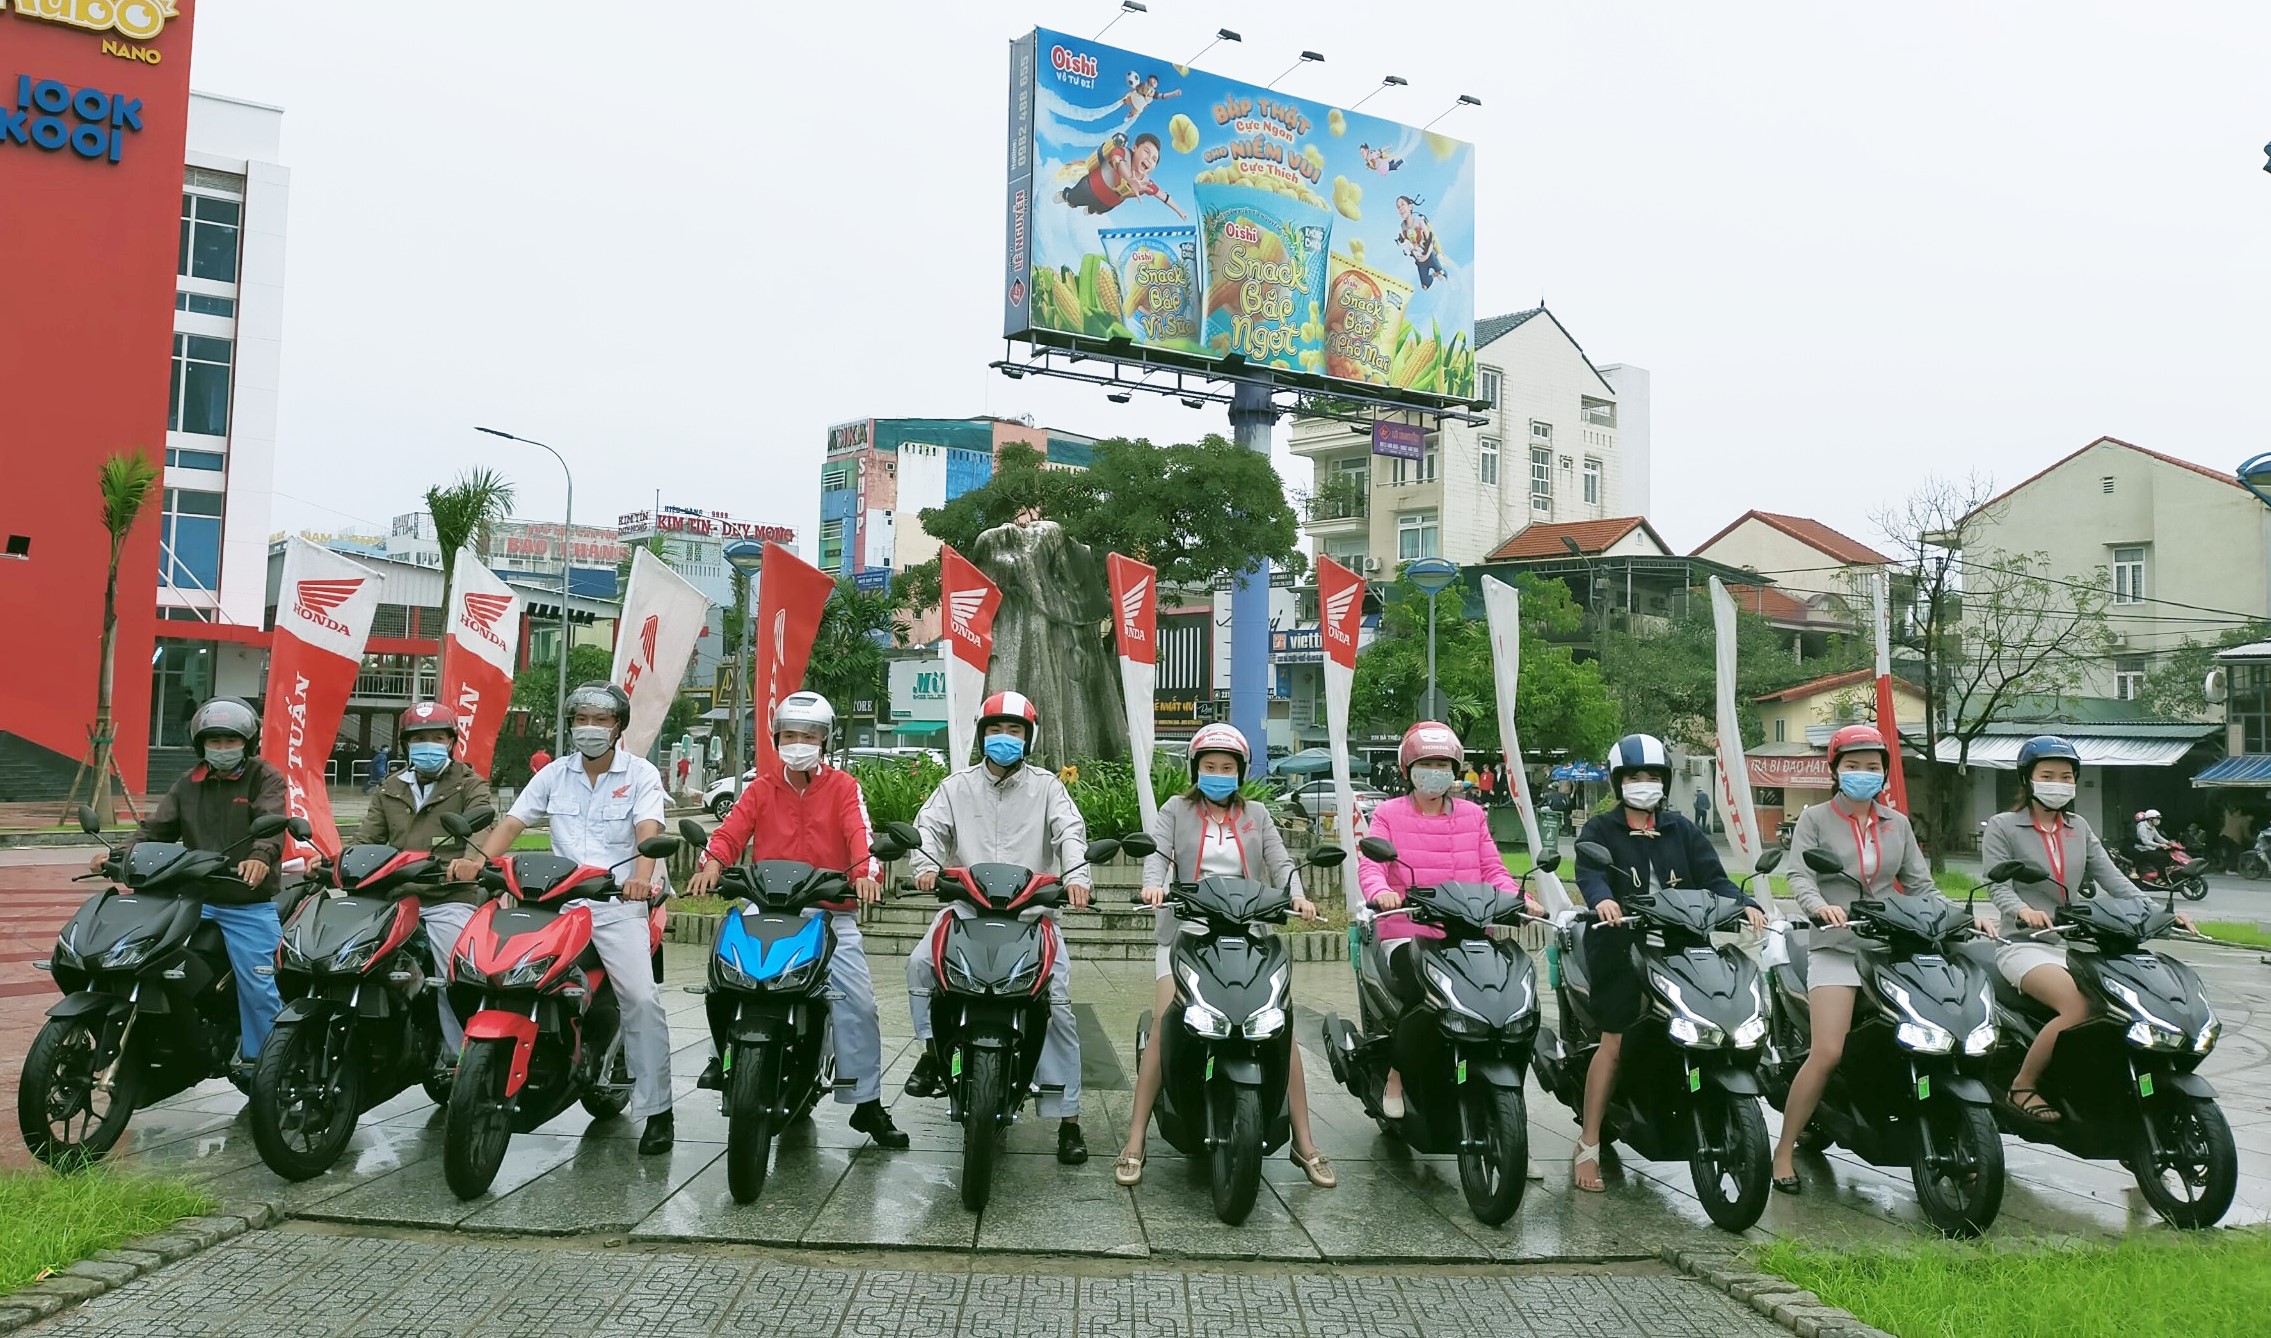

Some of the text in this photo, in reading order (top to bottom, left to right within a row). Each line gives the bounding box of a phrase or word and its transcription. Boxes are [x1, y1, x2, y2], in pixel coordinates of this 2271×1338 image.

[102, 38, 162, 65] NANO
[1051, 45, 1098, 78] Oishi
[1263, 120, 1293, 142] Ngon
[1267, 164, 1299, 184] Thích
[1287, 150, 1322, 184] VUI
[1224, 220, 1258, 243] Oishi
[1132, 252, 1153, 262] Oishi
[1222, 244, 1310, 294] Snack
[1135, 263, 1187, 288] Snack
[1240, 279, 1295, 326] Bắp
[1338, 287, 1385, 324] Snack
[1360, 343, 1392, 374] Mai
[855, 457, 867, 535] SHOP
[656, 514, 685, 532] KIM
[293, 602, 352, 637] HONDA
[460, 612, 507, 653] HONDA
[950, 620, 982, 648] ONDA
[1328, 625, 1351, 646] ONDA
[285, 670, 310, 770] TUẤN
[1783, 760, 1804, 773] ĐAO
